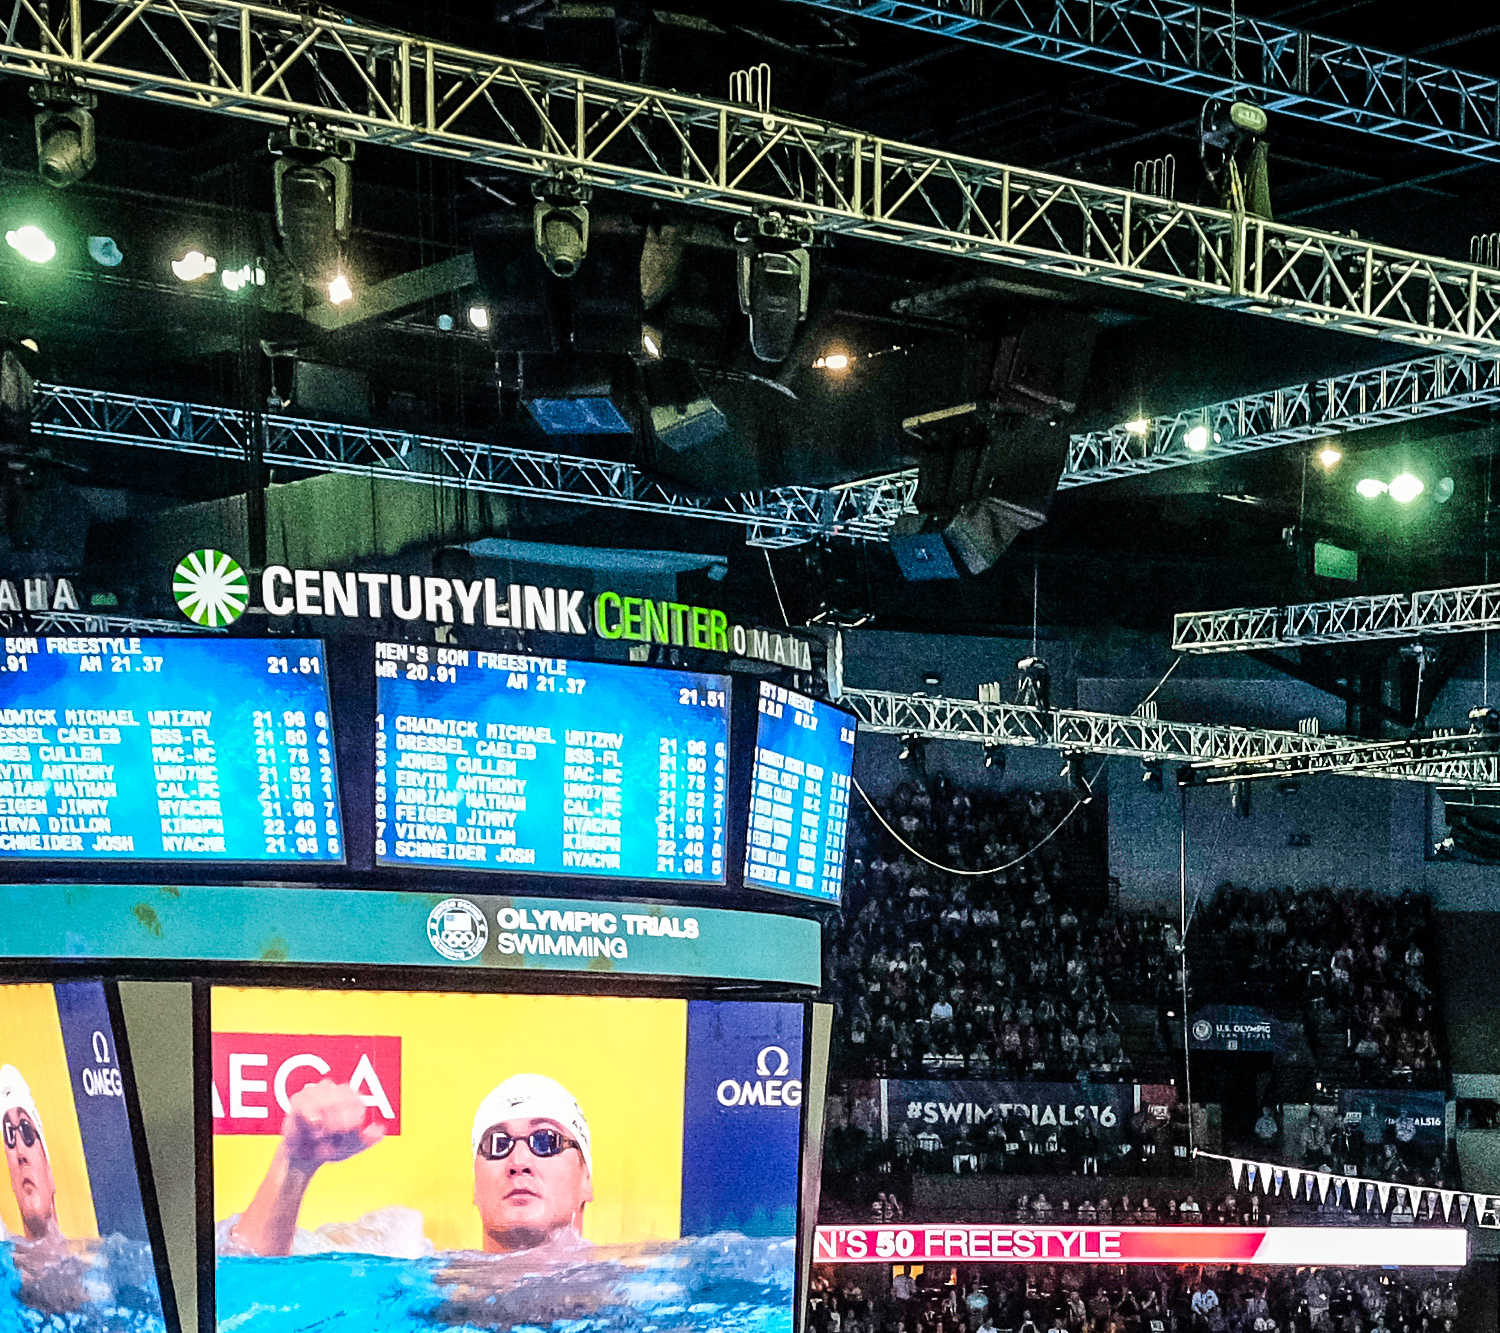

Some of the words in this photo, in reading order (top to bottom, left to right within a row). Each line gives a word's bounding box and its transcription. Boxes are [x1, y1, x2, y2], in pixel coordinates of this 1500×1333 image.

[262, 565, 586, 635] CENTURYLINK
[596, 591, 729, 652] CENTER
[733, 624, 812, 671] OMAHA
[5, 638, 38, 654] 50M
[46, 638, 142, 654] FREESTYLE
[111, 656, 163, 672] 21.37
[267, 657, 320, 674] 21.51
[376, 642, 428, 662] MEN'S
[437, 649, 469, 666] 50M
[478, 652, 567, 676] FREESTYLE
[375, 661, 398, 678] WR
[406, 664, 456, 683] 20.91
[537, 676, 586, 694] 21.37
[679, 688, 724, 707] 21.51
[65, 710, 140, 726] MICHAEL
[39, 746, 102, 762] CULLEN
[42, 765, 114, 780] ANTHONY
[54, 782, 117, 797] NATHAN
[57, 799, 108, 815] JIMMY
[48, 817, 111, 833] DILLON
[92, 836, 134, 851] JOSH
[496, 908, 617, 934] OLYMPIC
[622, 914, 699, 938] TRIALS
[498, 933, 628, 958] SWIMMING
[875, 1231, 914, 1258] 50
[925, 1230, 1121, 1258] FREESTYLE
